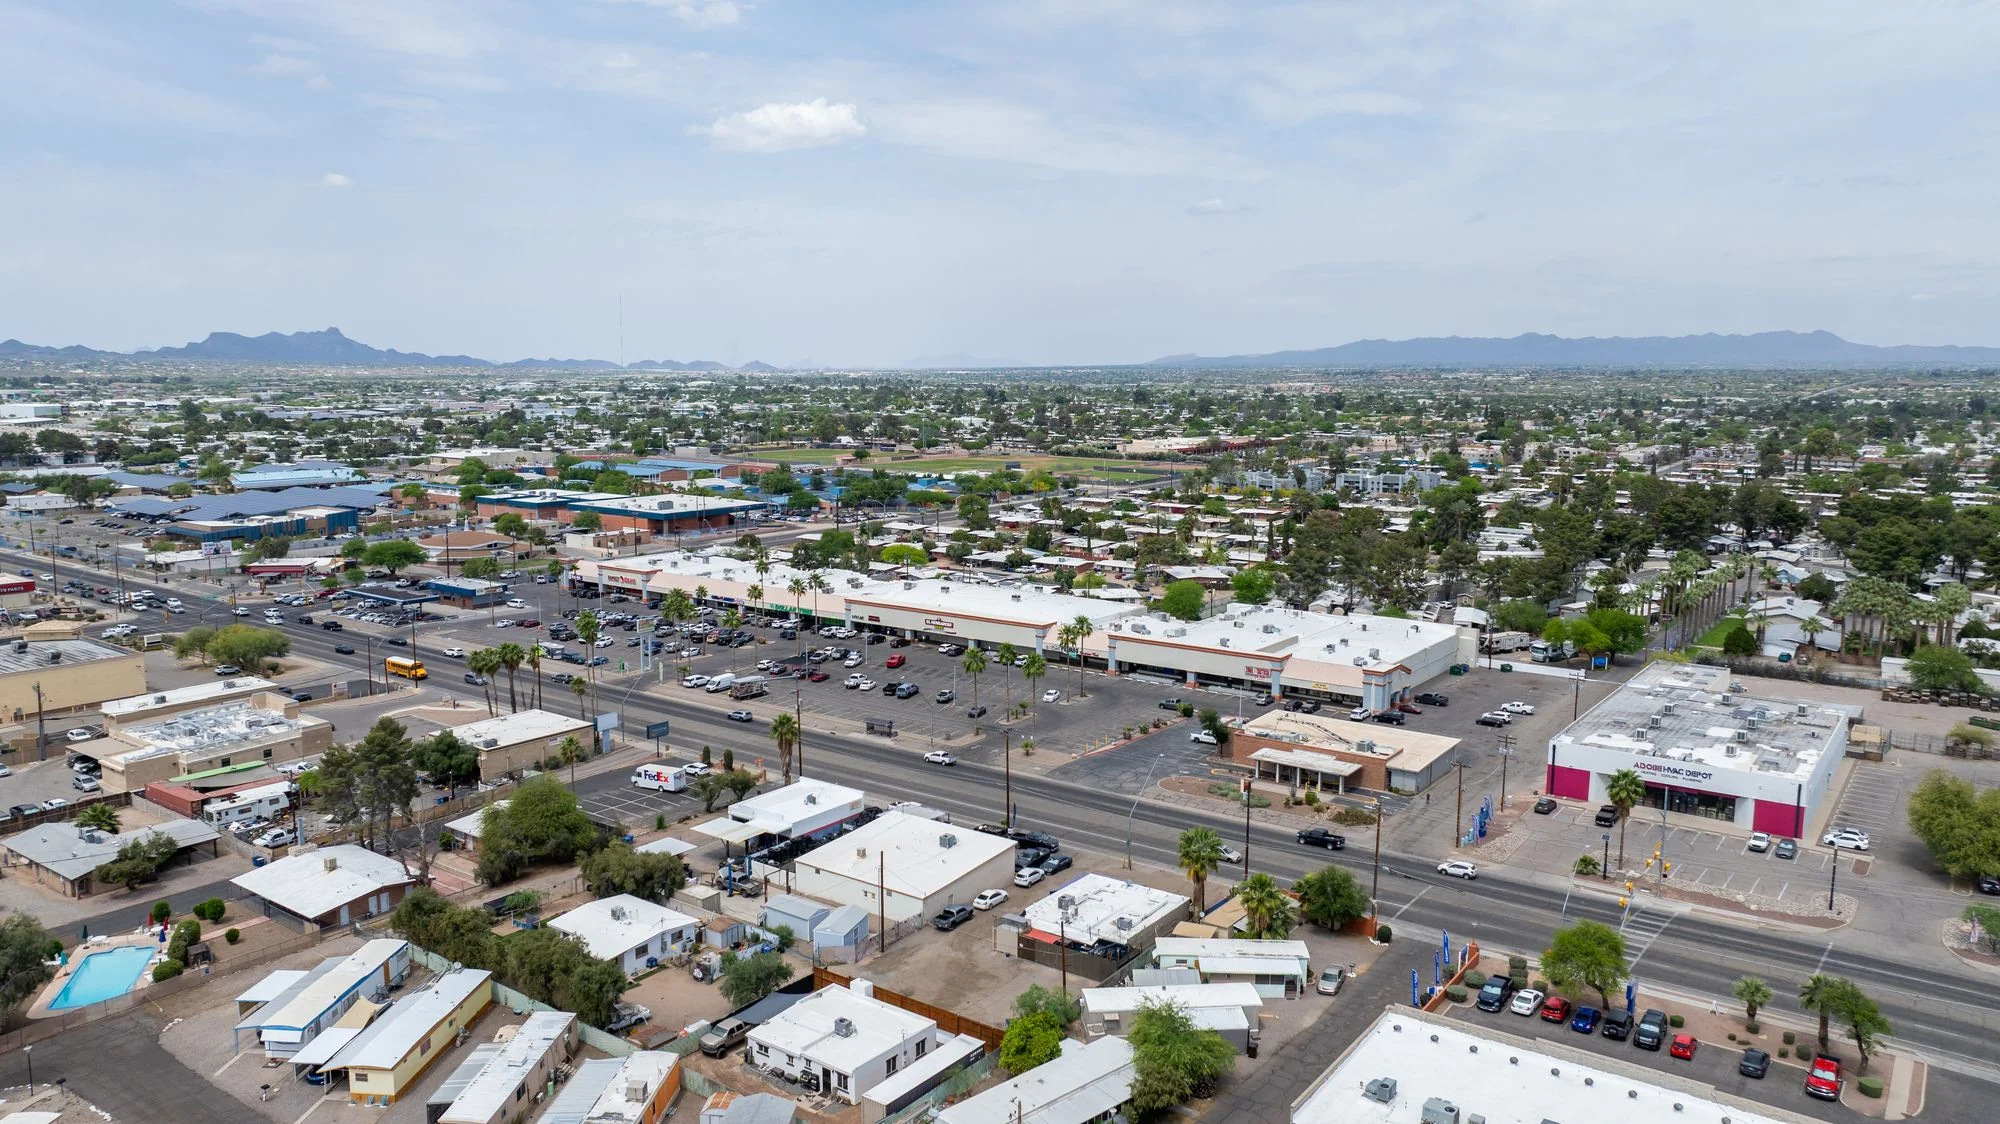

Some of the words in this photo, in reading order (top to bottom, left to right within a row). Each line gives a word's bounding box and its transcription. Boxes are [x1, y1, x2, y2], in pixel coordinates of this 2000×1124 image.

[644, 770, 669, 783] FedEx
[1633, 762, 1662, 772] ADOBE
[1663, 766, 1684, 775] HVAC
[1685, 769, 1712, 779] DEPOT
